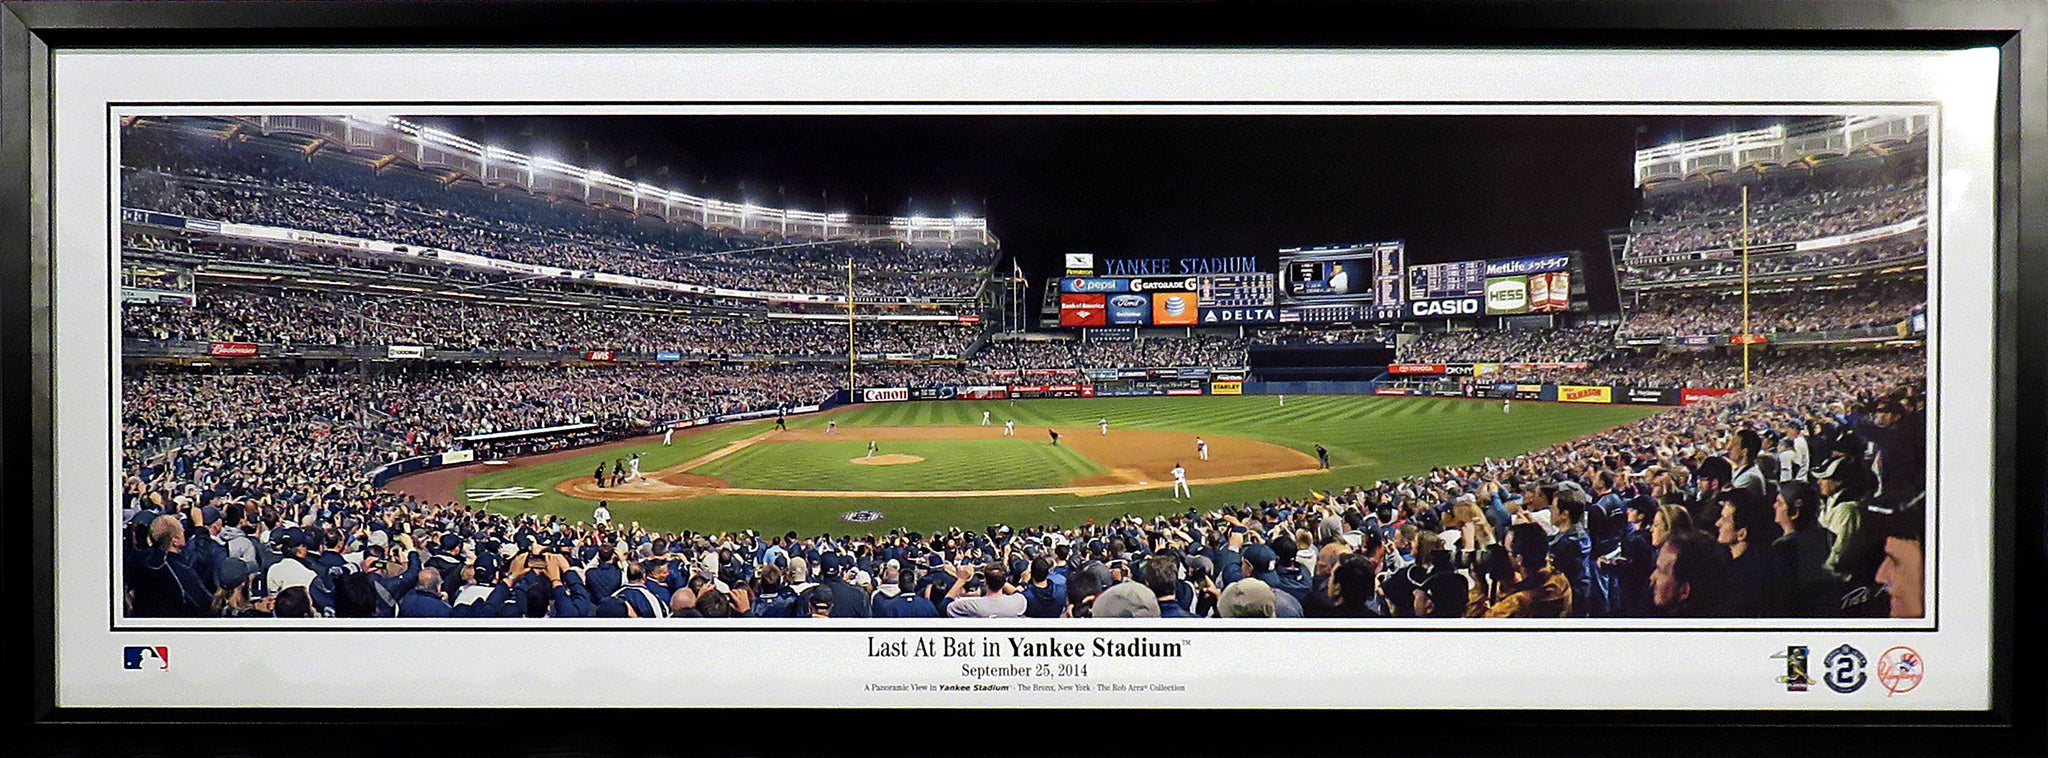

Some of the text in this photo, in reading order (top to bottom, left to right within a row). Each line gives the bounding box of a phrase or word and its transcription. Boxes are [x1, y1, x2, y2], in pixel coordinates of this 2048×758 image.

[1104, 256, 1256, 275] YANKEE STADIUM
[1486, 260, 1526, 275] MetLife
[1087, 280, 1117, 291] pepsi
[1490, 288, 1524, 301] HESS
[1117, 299, 1140, 307] Ford
[1412, 299, 1479, 317] CASIO
[1222, 309, 1275, 320] DELTA
[591, 351, 610, 360] AVIS
[1446, 366, 1474, 375] DKNY
[865, 389, 907, 401] Canon
[868, 636, 908, 657] Last
[914, 636, 937, 657] At
[943, 636, 976, 657] Bat
[982, 636, 1001, 657] in
[1008, 637, 1085, 657] Yankee
[961, 663, 1088, 679] September 25, 2014
[1837, 657, 1854, 683] 2
[872, 684, 910, 692] Panoramic
[930, 684, 938, 692] in
[939, 684, 971, 692] Yankee
